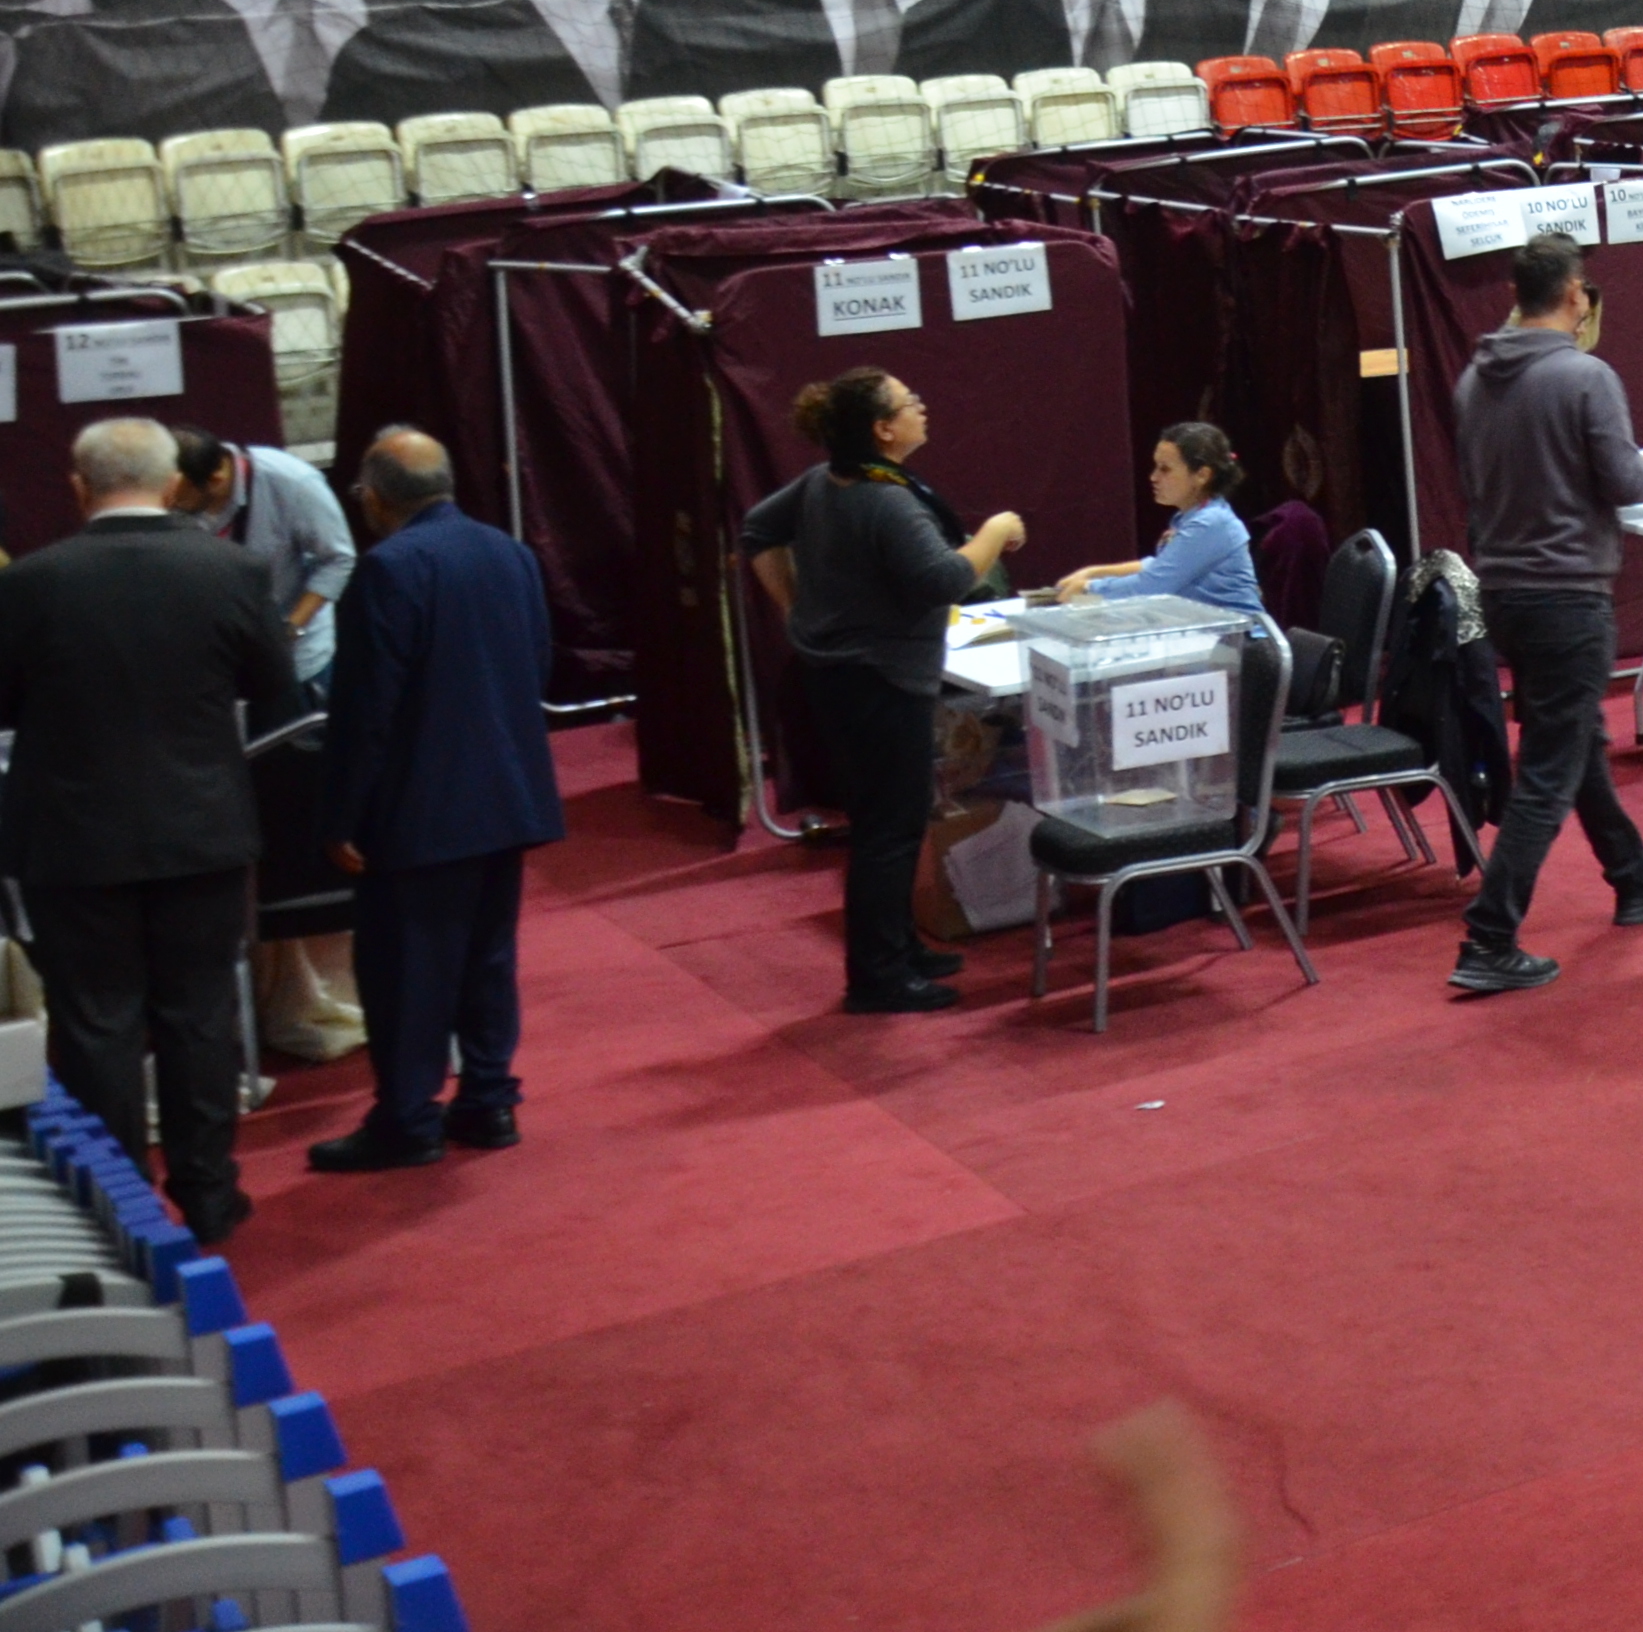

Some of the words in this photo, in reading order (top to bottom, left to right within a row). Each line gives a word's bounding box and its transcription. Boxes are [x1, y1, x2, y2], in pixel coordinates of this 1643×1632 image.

[1528, 201, 1543, 215] 10
[1546, 196, 1588, 212] NO'LU
[1610, 188, 1627, 203] 10
[1537, 218, 1588, 235] SANDIK
[960, 264, 979, 279] 11
[984, 257, 1035, 275] NO'LU
[822, 272, 844, 288] 11
[969, 283, 1032, 304] SANDIK
[833, 295, 905, 317] KONAK
[1125, 700, 1148, 718] 11
[1154, 689, 1215, 714] NO'LU
[1134, 721, 1208, 748] SANDIK
